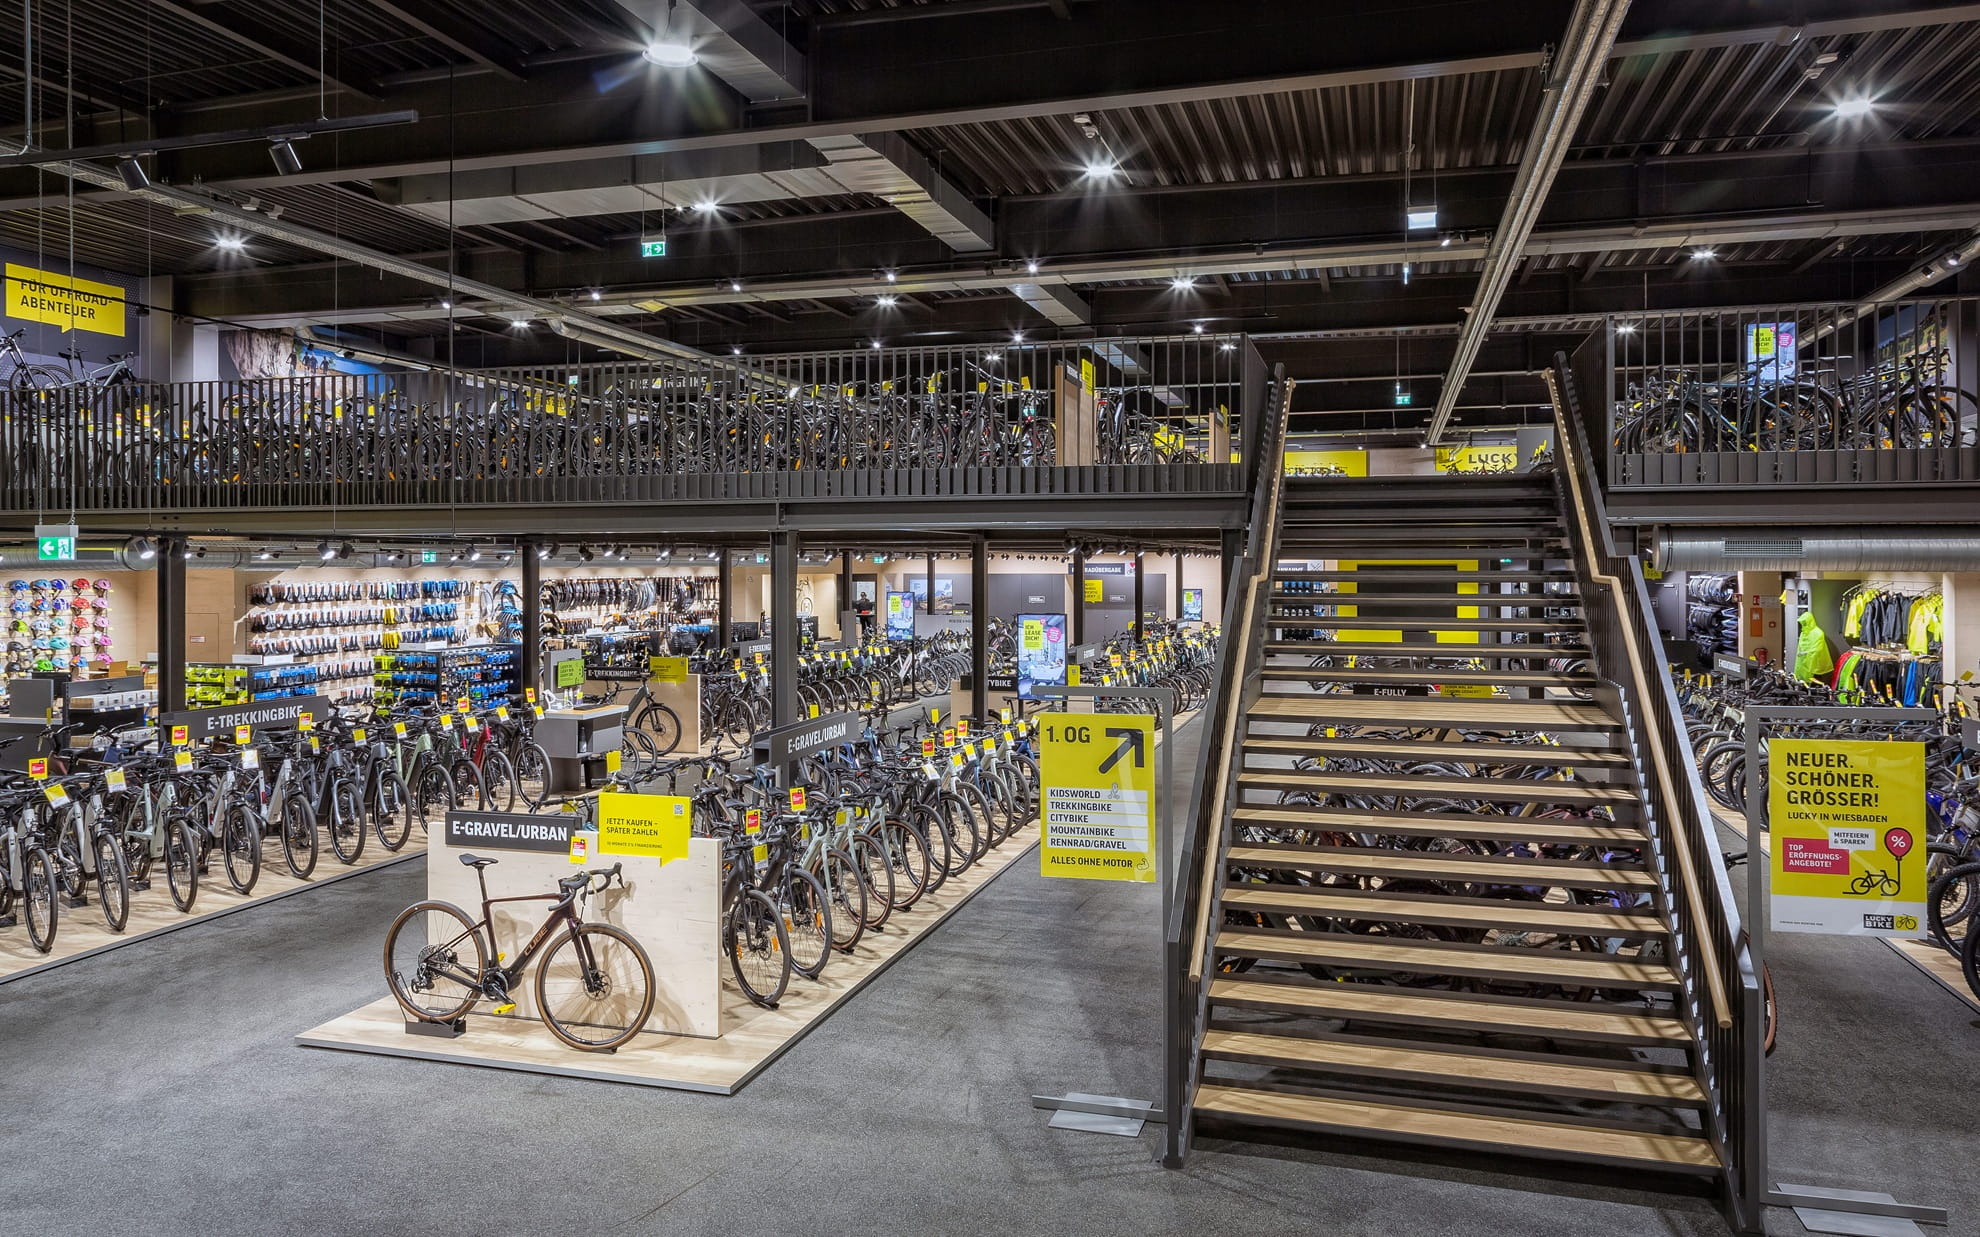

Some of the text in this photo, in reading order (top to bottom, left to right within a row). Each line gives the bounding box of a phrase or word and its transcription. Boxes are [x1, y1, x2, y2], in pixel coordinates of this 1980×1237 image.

[20, 295, 95, 319] ABENTEUER
[1374, 688, 1407, 696] E-FULLY
[207, 705, 303, 730] E-TREKKINGBIKE
[787, 722, 846, 754] E-GRAVEL/URBAN
[1046, 726, 1091, 743] 1. OG
[1786, 752, 1854, 768] NEUER.
[1786, 770, 1879, 788] SCHÖNER.
[1050, 788, 1101, 799] KIDSWORLD
[1786, 789, 1879, 807] GRÖSSER!
[1050, 801, 1112, 812] TREKKINGBIKE
[606, 817, 625, 826] JETZT
[627, 819, 653, 827] KAUFEN
[1050, 813, 1089, 823] CITYBIKE
[1787, 811, 1888, 823] LUCKY IN WIESBADEN
[452, 820, 568, 842] E-GRAVEL/URBAN
[606, 826, 658, 836] SPÄTER ZAHLEN
[1050, 826, 1115, 837] MOUNTAINBIKE
[1834, 831, 1870, 839] MITFEIERN
[1050, 838, 1127, 850] RENNRAD/GRAVEL
[1788, 843, 1804, 851] TOP
[1840, 838, 1866, 846] SPAREN
[1891, 835, 1906, 848] %
[1788, 850, 1843, 861] ERÖFFNUNGS-
[1050, 856, 1133, 868] ALLES OHNE MOTOR
[1788, 859, 1832, 868] ANGEBOTE!
[1865, 920, 1893, 929] BIKE
